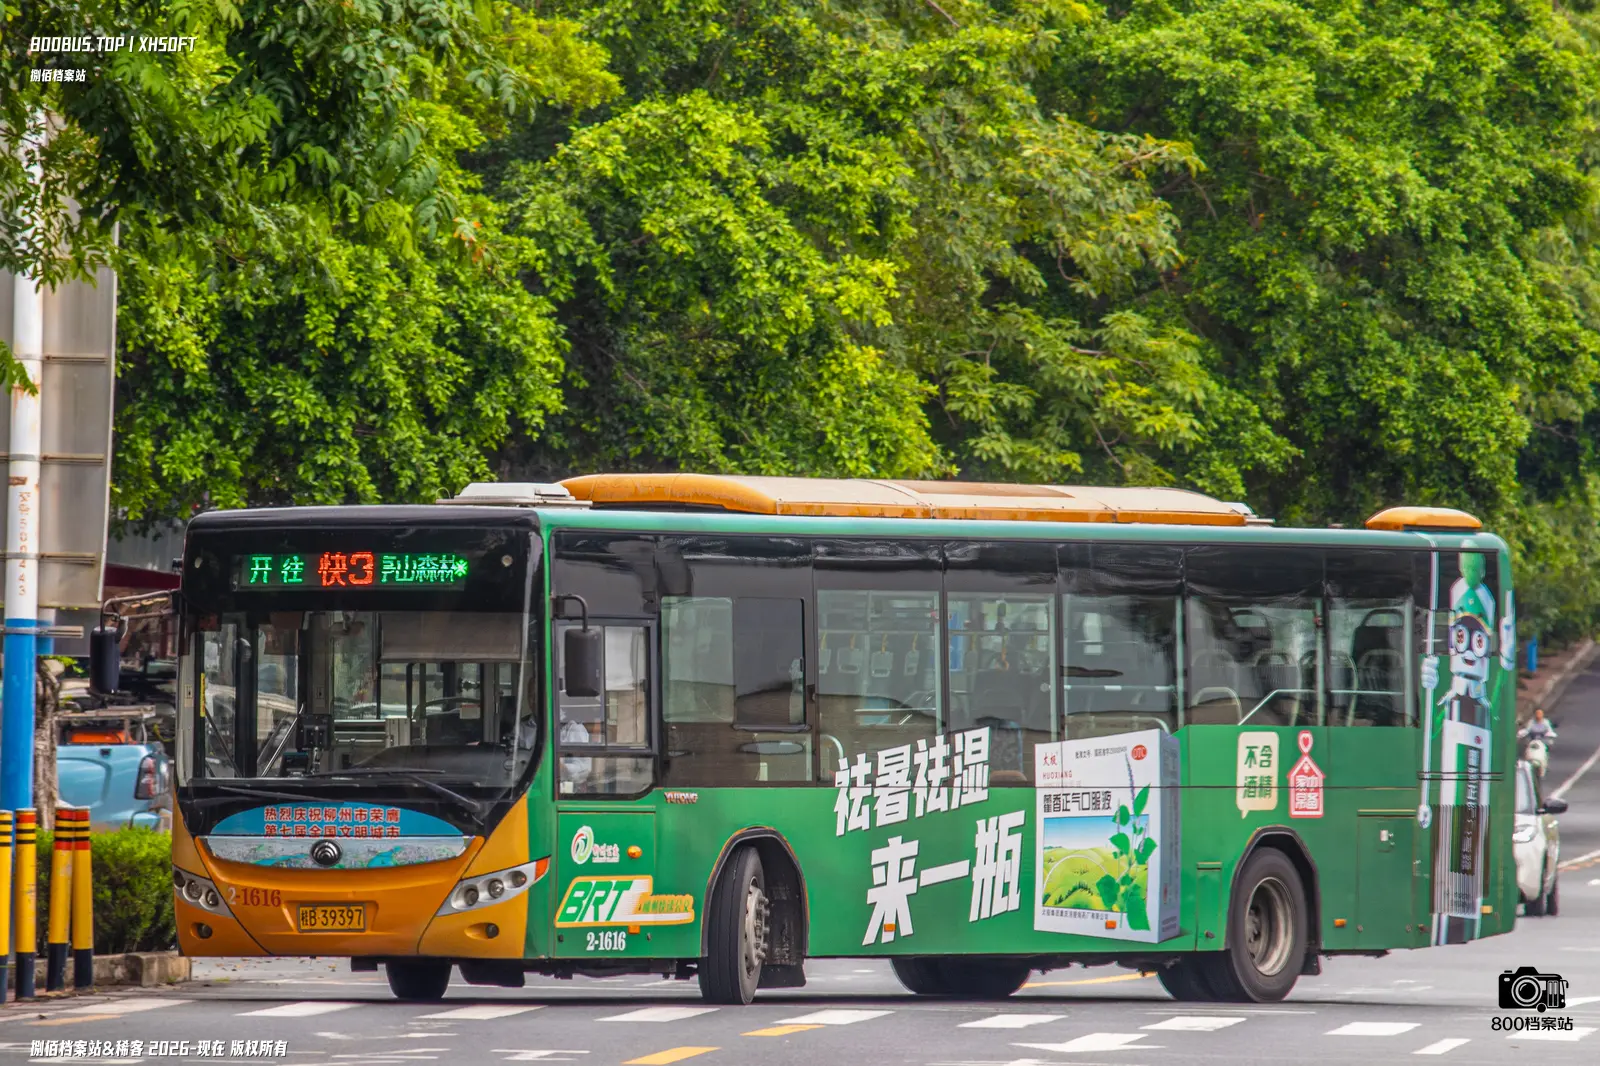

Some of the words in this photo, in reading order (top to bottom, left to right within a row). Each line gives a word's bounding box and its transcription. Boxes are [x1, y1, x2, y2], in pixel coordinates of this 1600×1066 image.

[250, 555, 304, 583] 开往
[318, 552, 374, 586] 快3
[1244, 745, 1272, 768] 不含
[833, 726, 991, 837] 祛暑祛湿
[1243, 775, 1272, 799] 酒精
[264, 807, 400, 822] 热烈庆祝柳州市荣膺
[264, 824, 400, 838] 第七届全国文明城市
[862, 810, 1026, 946] 来一瓶
[227, 887, 281, 907] 2-1616
[557, 880, 634, 922] BRT
[586, 931, 626, 951] 2-1616
